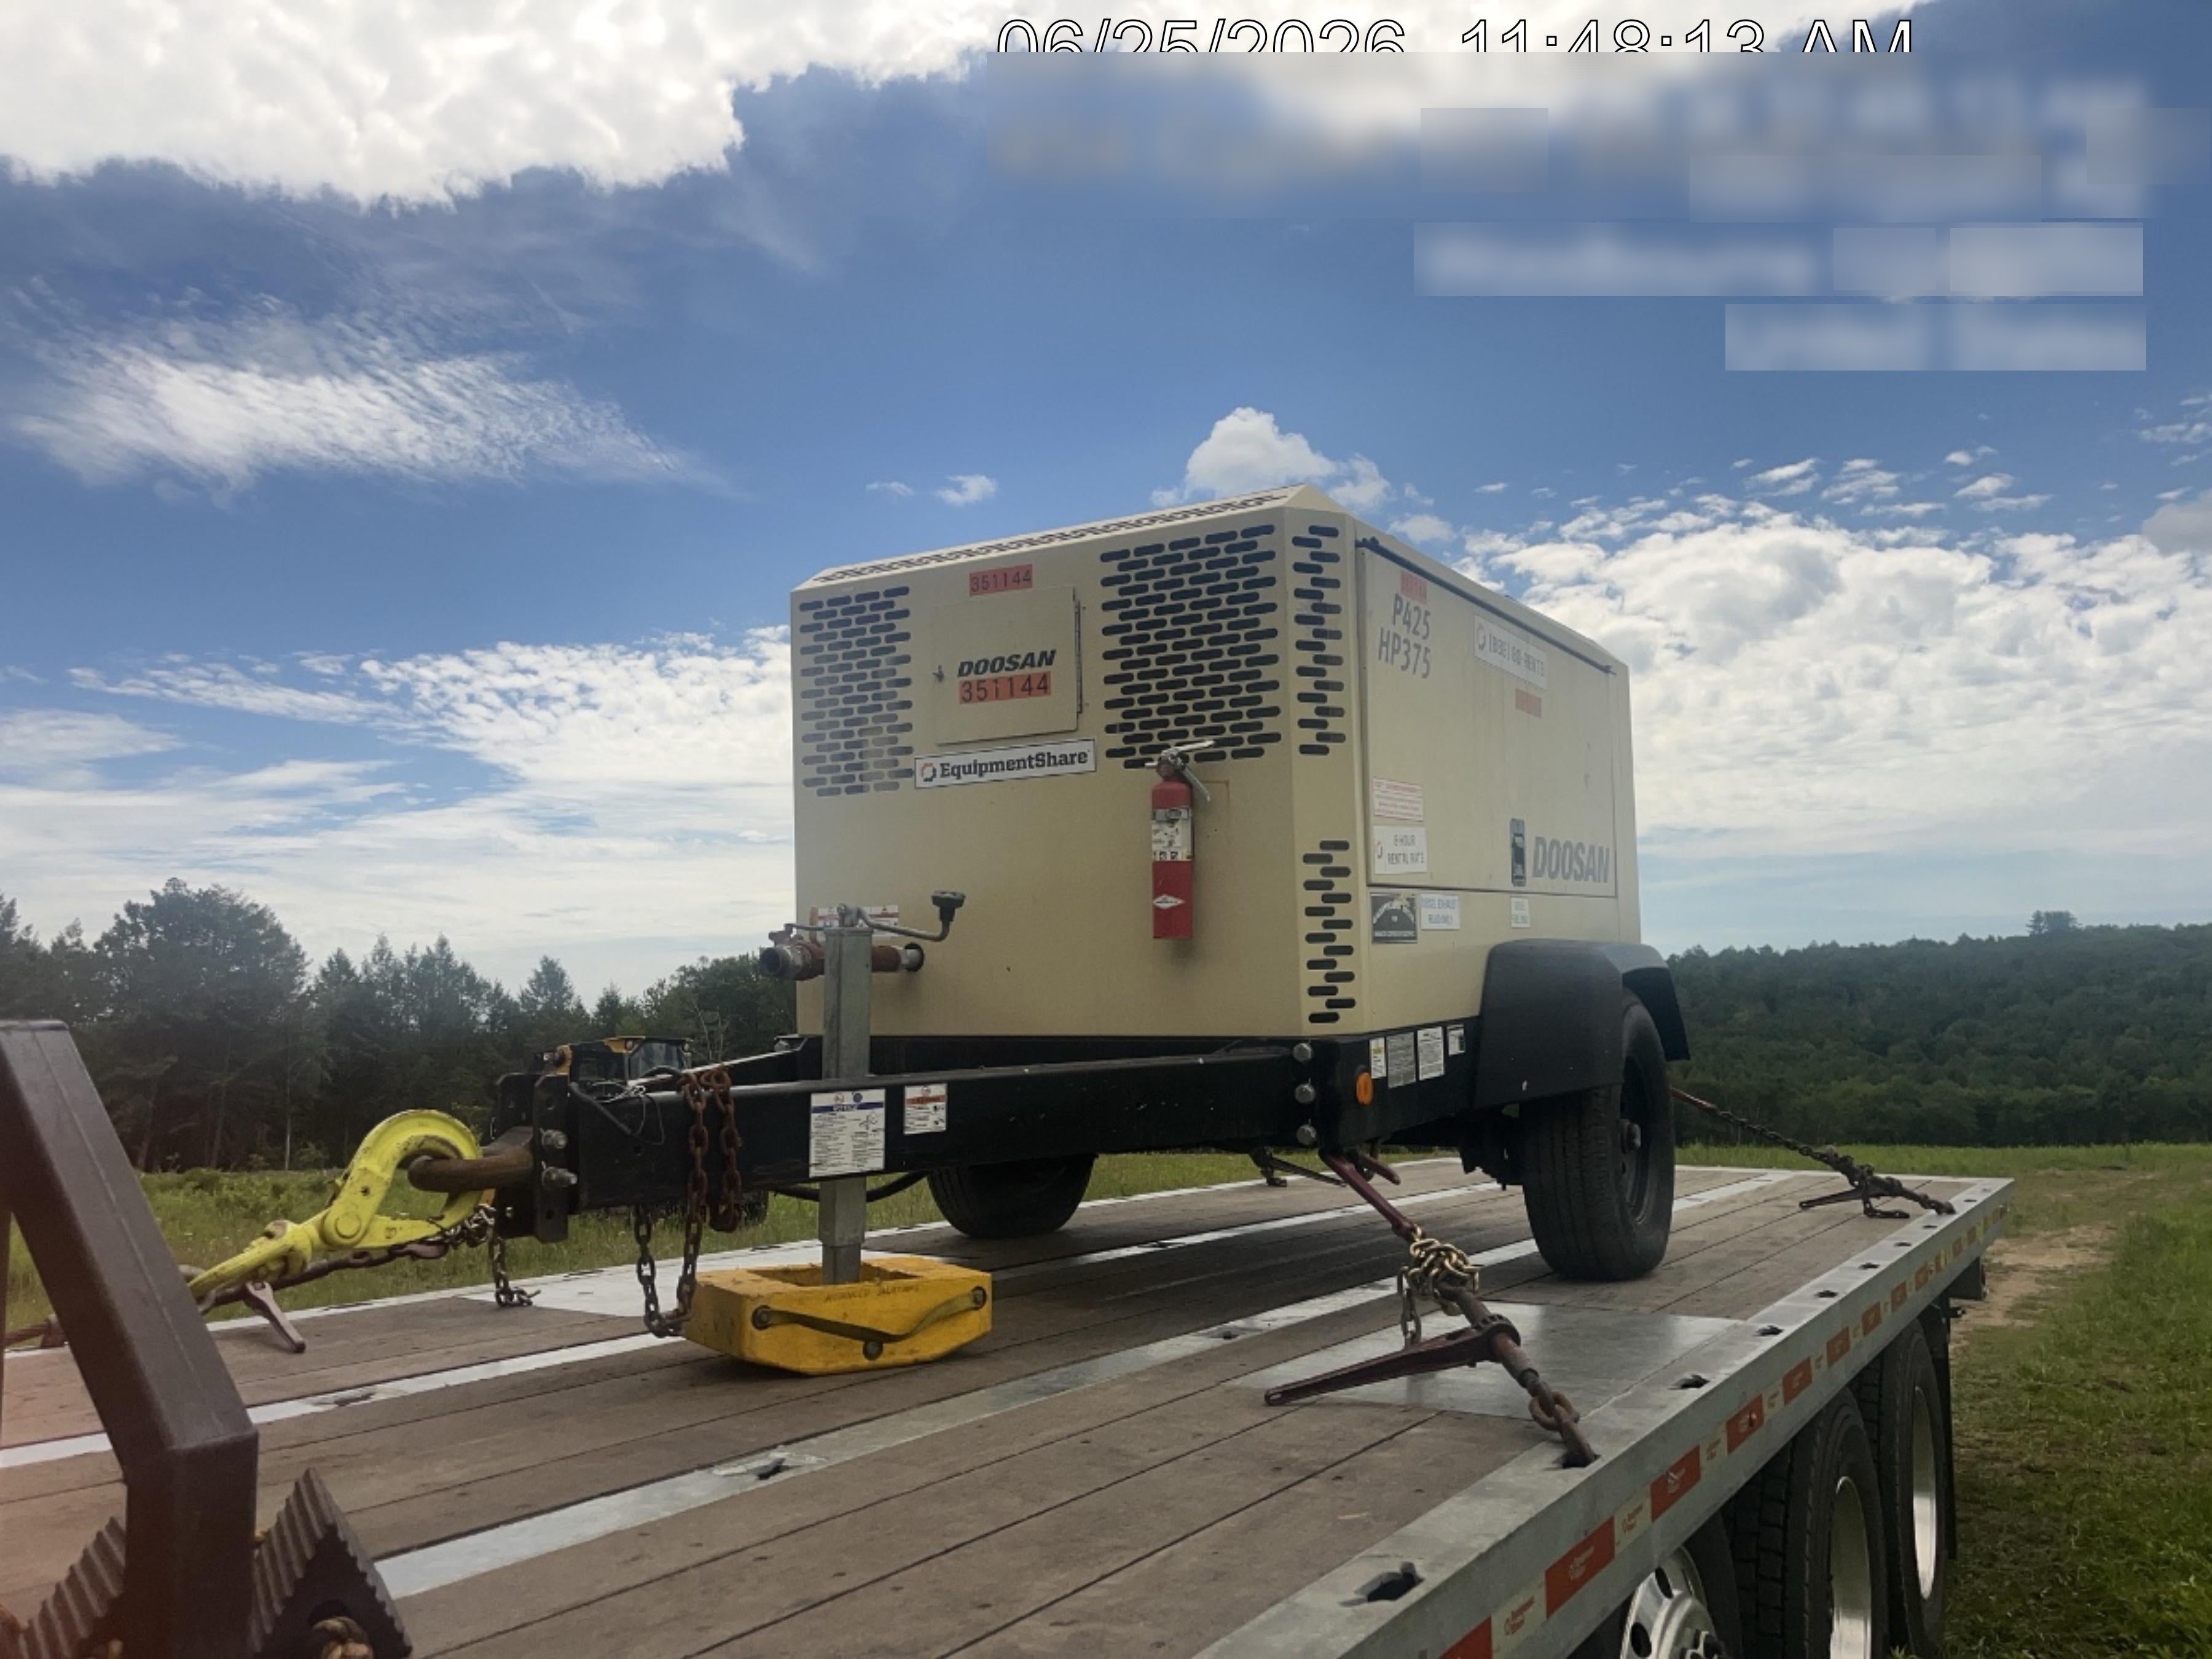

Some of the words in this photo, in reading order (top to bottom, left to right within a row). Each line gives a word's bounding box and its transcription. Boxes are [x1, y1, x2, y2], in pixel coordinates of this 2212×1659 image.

[971, 570, 1032, 592] 351144
[1392, 593, 1431, 640] P425
[957, 649, 1057, 677] DOOSAN
[1378, 627, 1431, 679] HP375
[962, 674, 1048, 703] 351144
[939, 750, 1088, 781] EquipmentShare
[1532, 836, 1610, 884] DOOSAN
